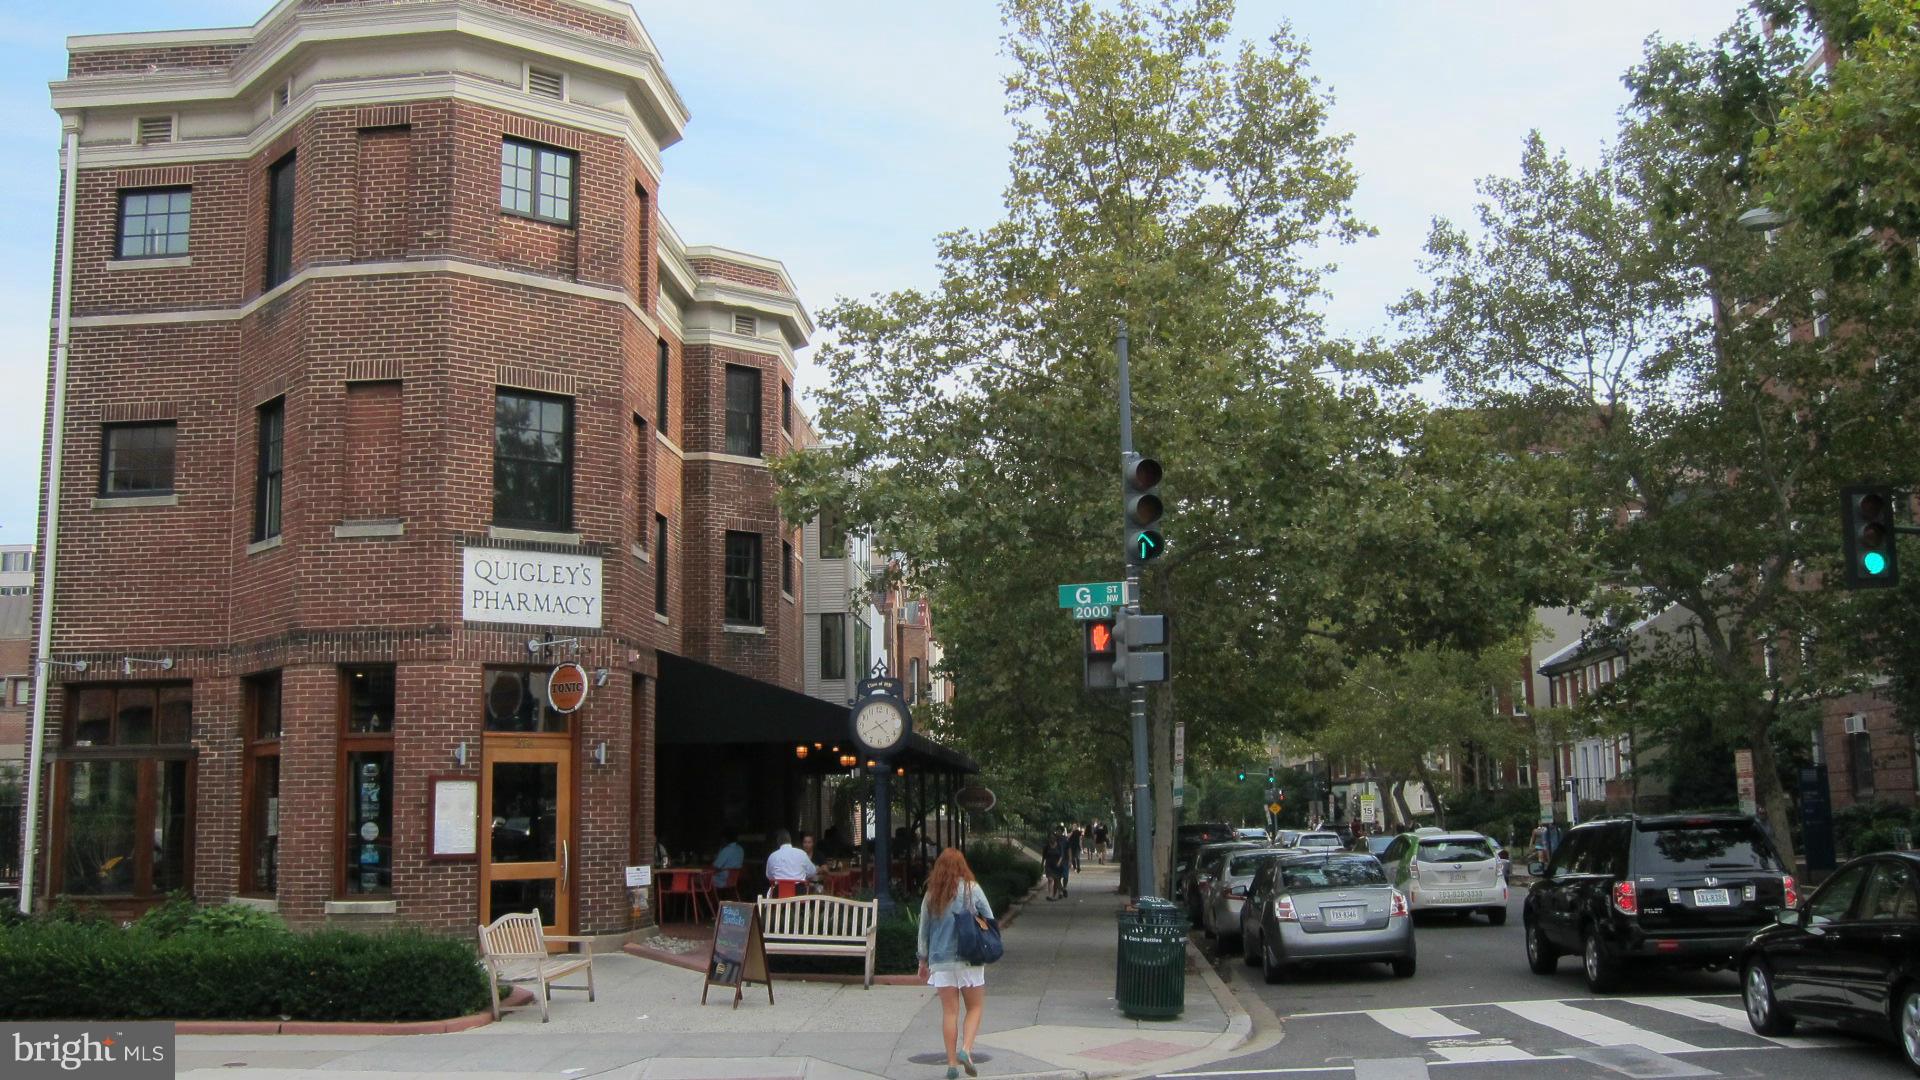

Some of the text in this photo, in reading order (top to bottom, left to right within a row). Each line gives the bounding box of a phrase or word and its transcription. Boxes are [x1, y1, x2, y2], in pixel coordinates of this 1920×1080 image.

[474, 559, 592, 586] QUIGLEY'S
[1075, 585, 1118, 604] G ST
[1106, 594, 1119, 602] NW
[472, 589, 596, 615] PHARMACY
[1076, 605, 1109, 618] 2000
[552, 682, 582, 694] TONIC
[1363, 807, 1373, 815] 15
